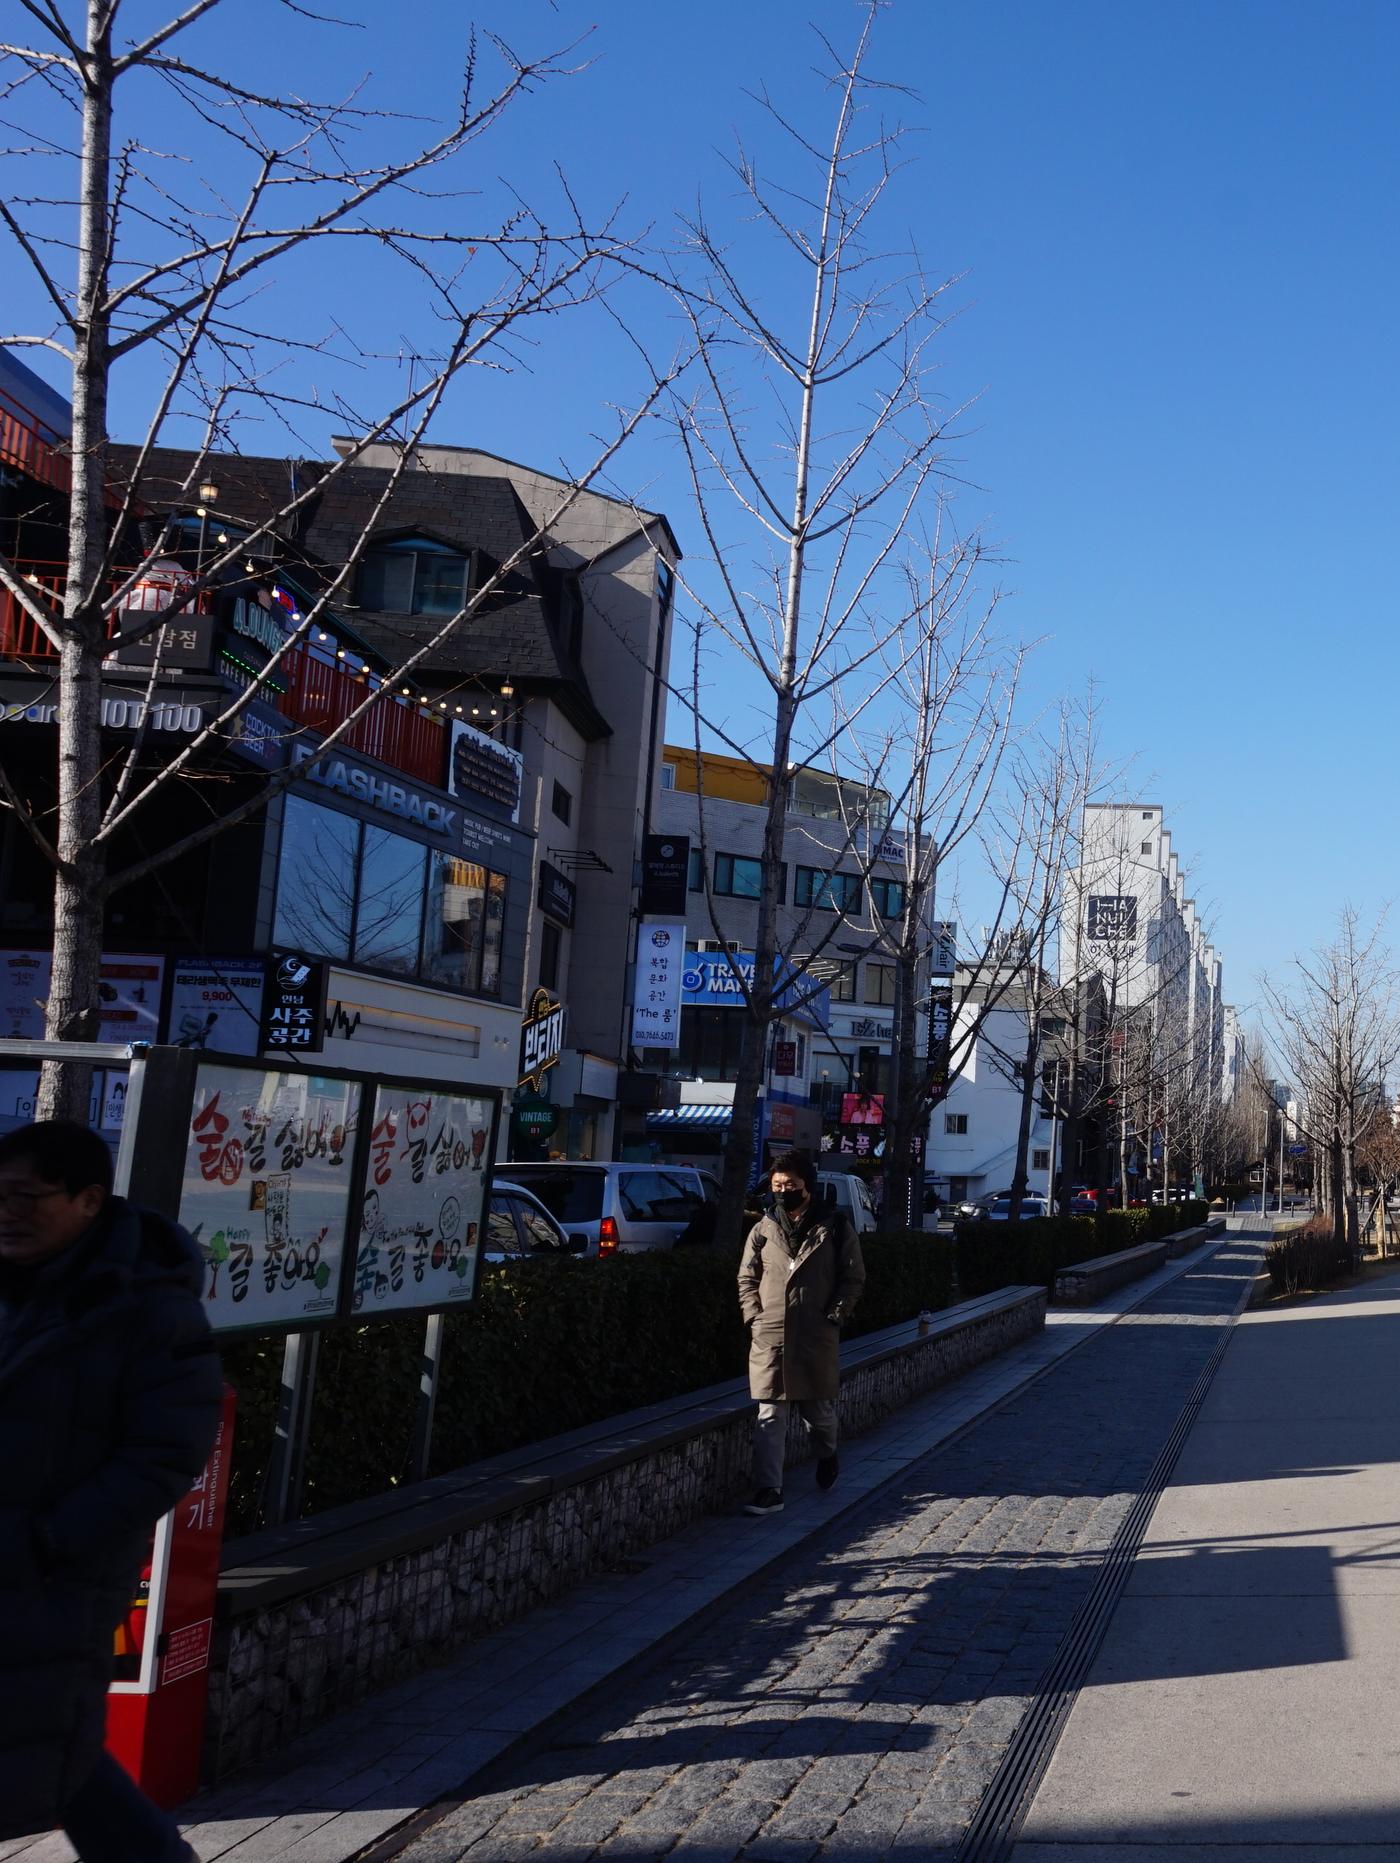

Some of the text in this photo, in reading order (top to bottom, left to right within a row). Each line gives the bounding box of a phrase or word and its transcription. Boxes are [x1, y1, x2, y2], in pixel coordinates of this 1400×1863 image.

[708, 963, 756, 978] TRAVE
[708, 978, 754, 993] MAKE
[202, 991, 232, 1002] 9,900
[268, 1006, 314, 1025] 사주
[268, 1026, 313, 1045] 공간
[524, 1008, 564, 1074] 빈티지
[520, 1111, 553, 1123] VINTAGE
[840, 1133, 870, 1156] 소풍
